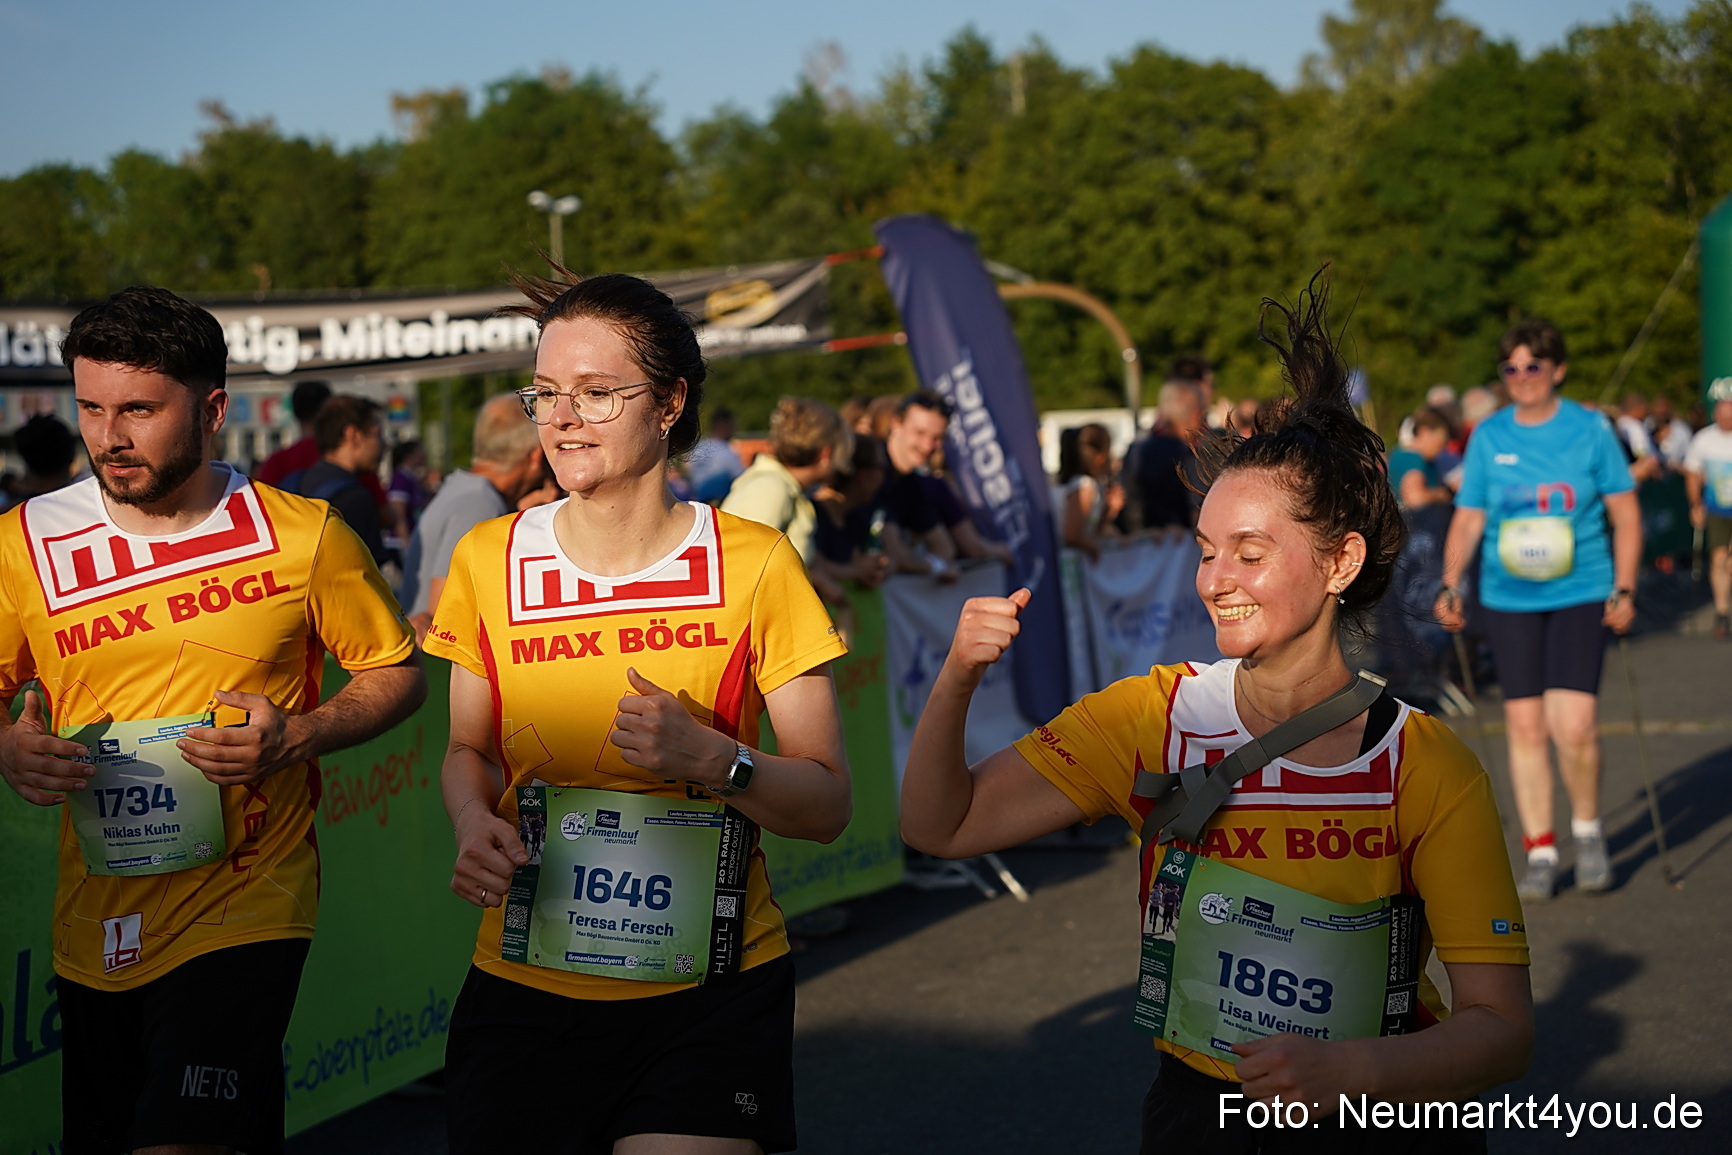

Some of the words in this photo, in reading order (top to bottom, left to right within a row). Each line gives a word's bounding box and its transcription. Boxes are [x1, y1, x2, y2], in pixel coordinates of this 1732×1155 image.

[224, 315, 314, 375] tig.
[54, 603, 155, 659] MAX
[166, 570, 291, 624] BÖGL
[511, 631, 604, 665] MAX
[618, 618, 728, 653] BÖGL
[94, 750, 137, 764] Firmenlauf
[94, 784, 178, 818] 1734
[520, 798, 542, 807] AOK
[103, 826, 141, 839] Niklas
[144, 823, 181, 836] Kuhn
[586, 826, 639, 839] Firmenlauf
[721, 816, 733, 858] RABATT
[1285, 819, 1400, 859] BÖGL
[720, 859, 727, 868] %
[727, 847, 737, 885] FACTORY
[732, 819, 741, 848] OUTLET
[718, 868, 725, 884] 20
[1162, 863, 1186, 878] AOK
[573, 865, 672, 910] 1646
[567, 911, 616, 931] Teresa
[621, 918, 673, 936] Fersch
[1231, 913, 1294, 937] Firmenlauf
[1391, 907, 1399, 956] RABATT
[1255, 929, 1292, 943] neumarkt
[567, 953, 622, 965] firmenlauf.bayern
[1218, 950, 1333, 1014] 1863
[1389, 966, 1397, 982] 20
[1219, 998, 1252, 1023] Lisa
[1258, 1011, 1329, 1039] Weigert
[1223, 1019, 1234, 1027] Max
[1235, 1023, 1247, 1031] Bögl
[1248, 1028, 1272, 1038] Bauservi
[1213, 1041, 1232, 1052] firme
[180, 1065, 239, 1101] NETS
